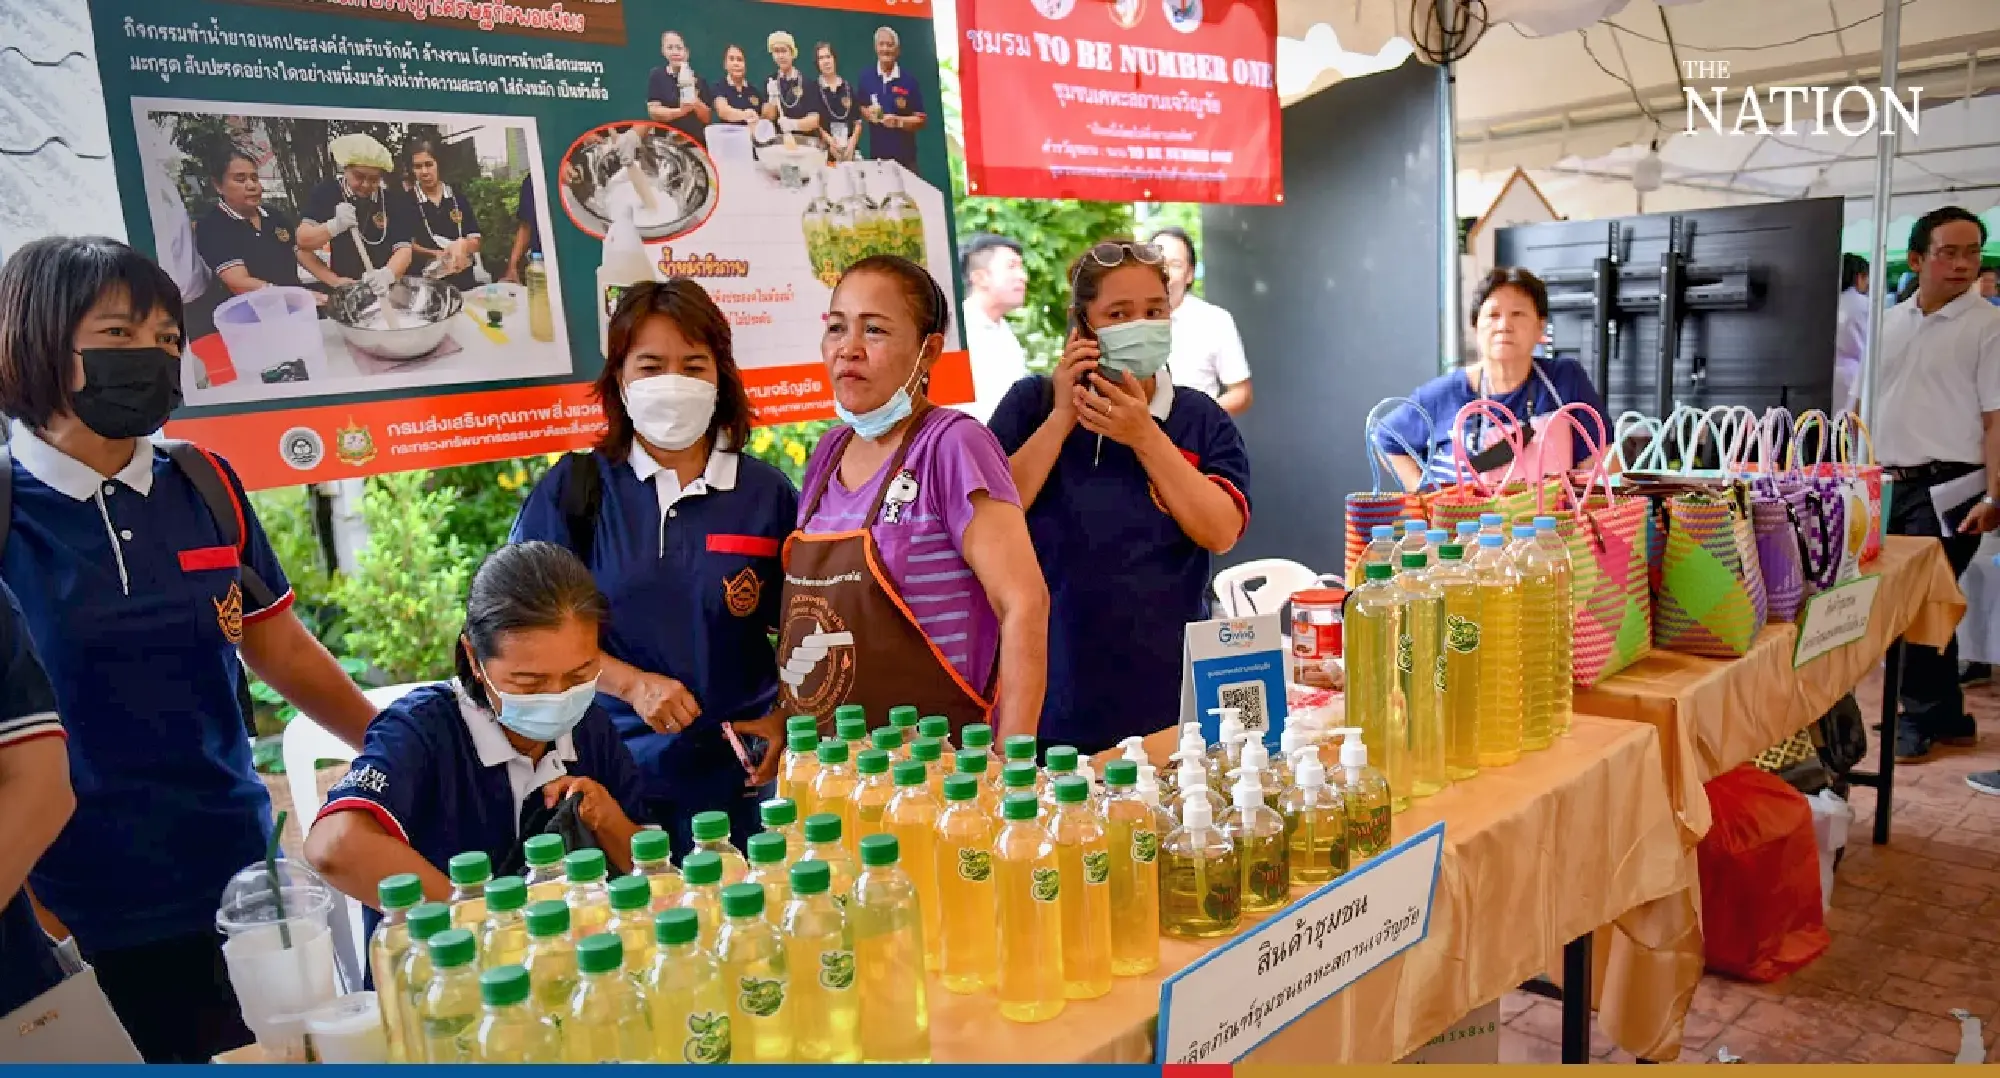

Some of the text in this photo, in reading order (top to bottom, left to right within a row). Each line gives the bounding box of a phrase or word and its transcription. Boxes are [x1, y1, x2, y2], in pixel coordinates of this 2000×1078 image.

[967, 29, 1274, 89] ชมรม TO BE NUMBER ONE
[1256, 894, 1368, 976] สินค้าชุมชน
